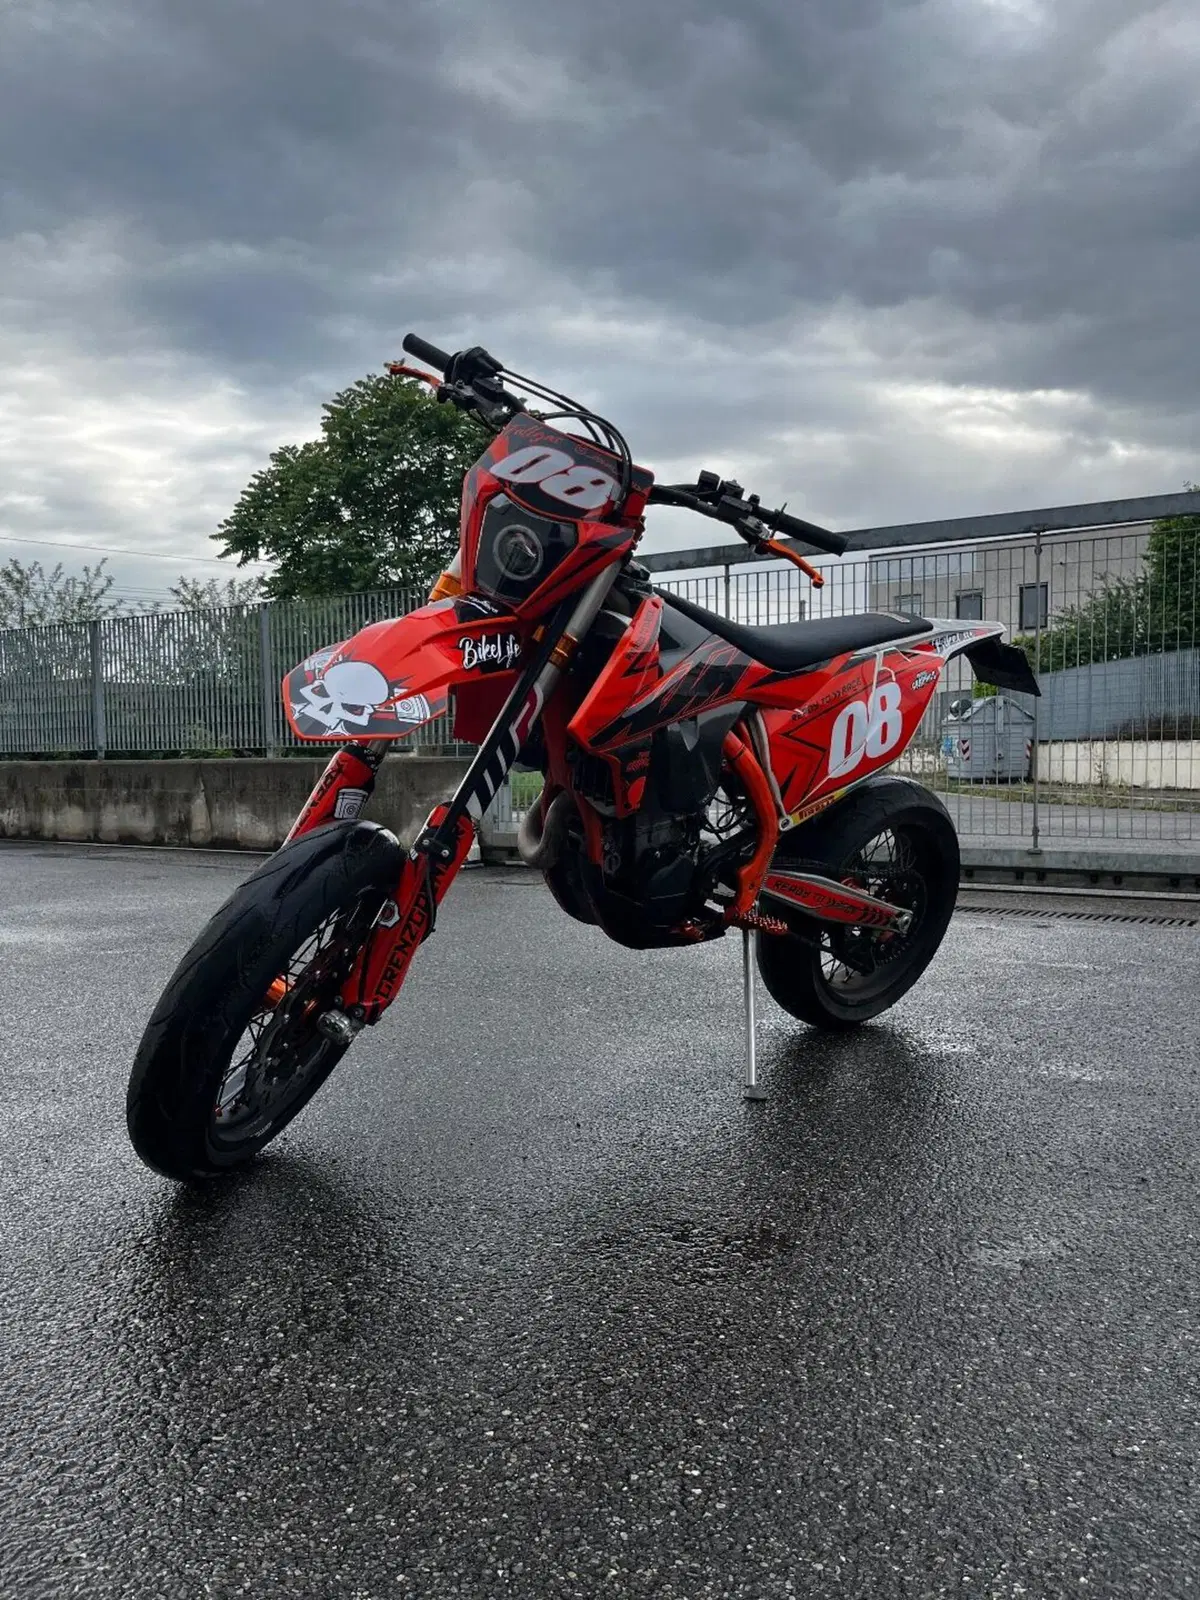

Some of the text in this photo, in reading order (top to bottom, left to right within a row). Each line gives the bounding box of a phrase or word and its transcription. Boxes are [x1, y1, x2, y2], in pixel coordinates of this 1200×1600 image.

[489, 446, 622, 510] 08
[458, 633, 521, 670] BikeLife
[828, 681, 902, 779] 08
